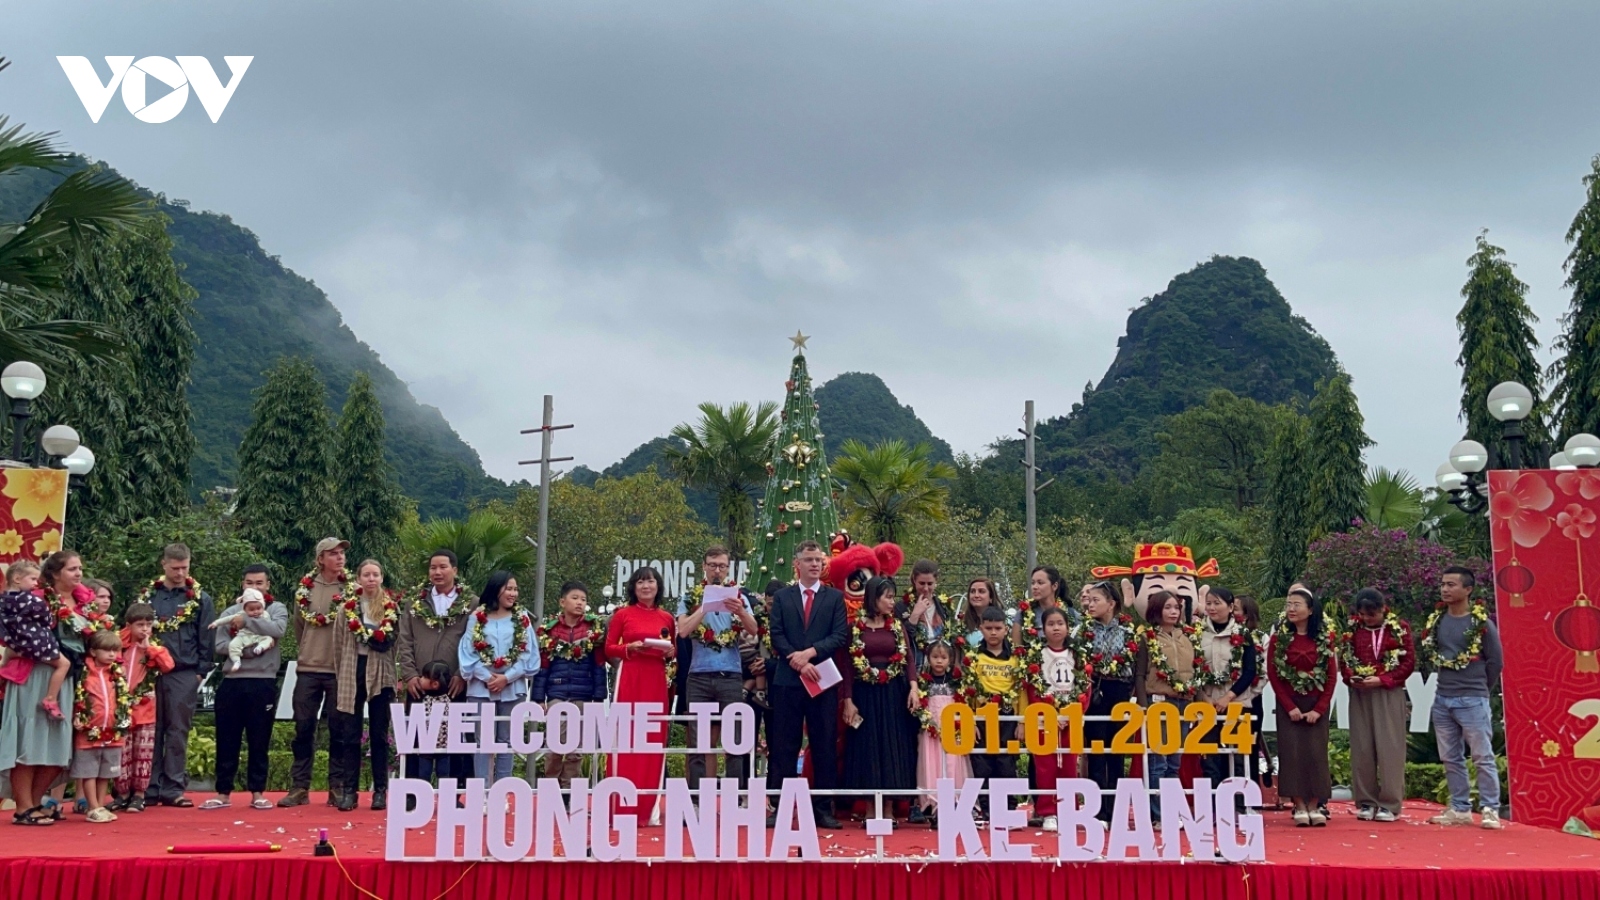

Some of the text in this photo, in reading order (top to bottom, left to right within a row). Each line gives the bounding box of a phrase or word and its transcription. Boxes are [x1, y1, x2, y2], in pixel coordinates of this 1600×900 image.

[616, 559, 695, 598] PNG
[1056, 669, 1070, 682] 11
[389, 702, 755, 755] WELCOME TO
[941, 702, 1256, 755] 01.01.2024
[385, 777, 638, 862] PHONG
[665, 777, 822, 862] NHA
[936, 777, 1032, 862] KE
[1056, 777, 1265, 862] BANG
